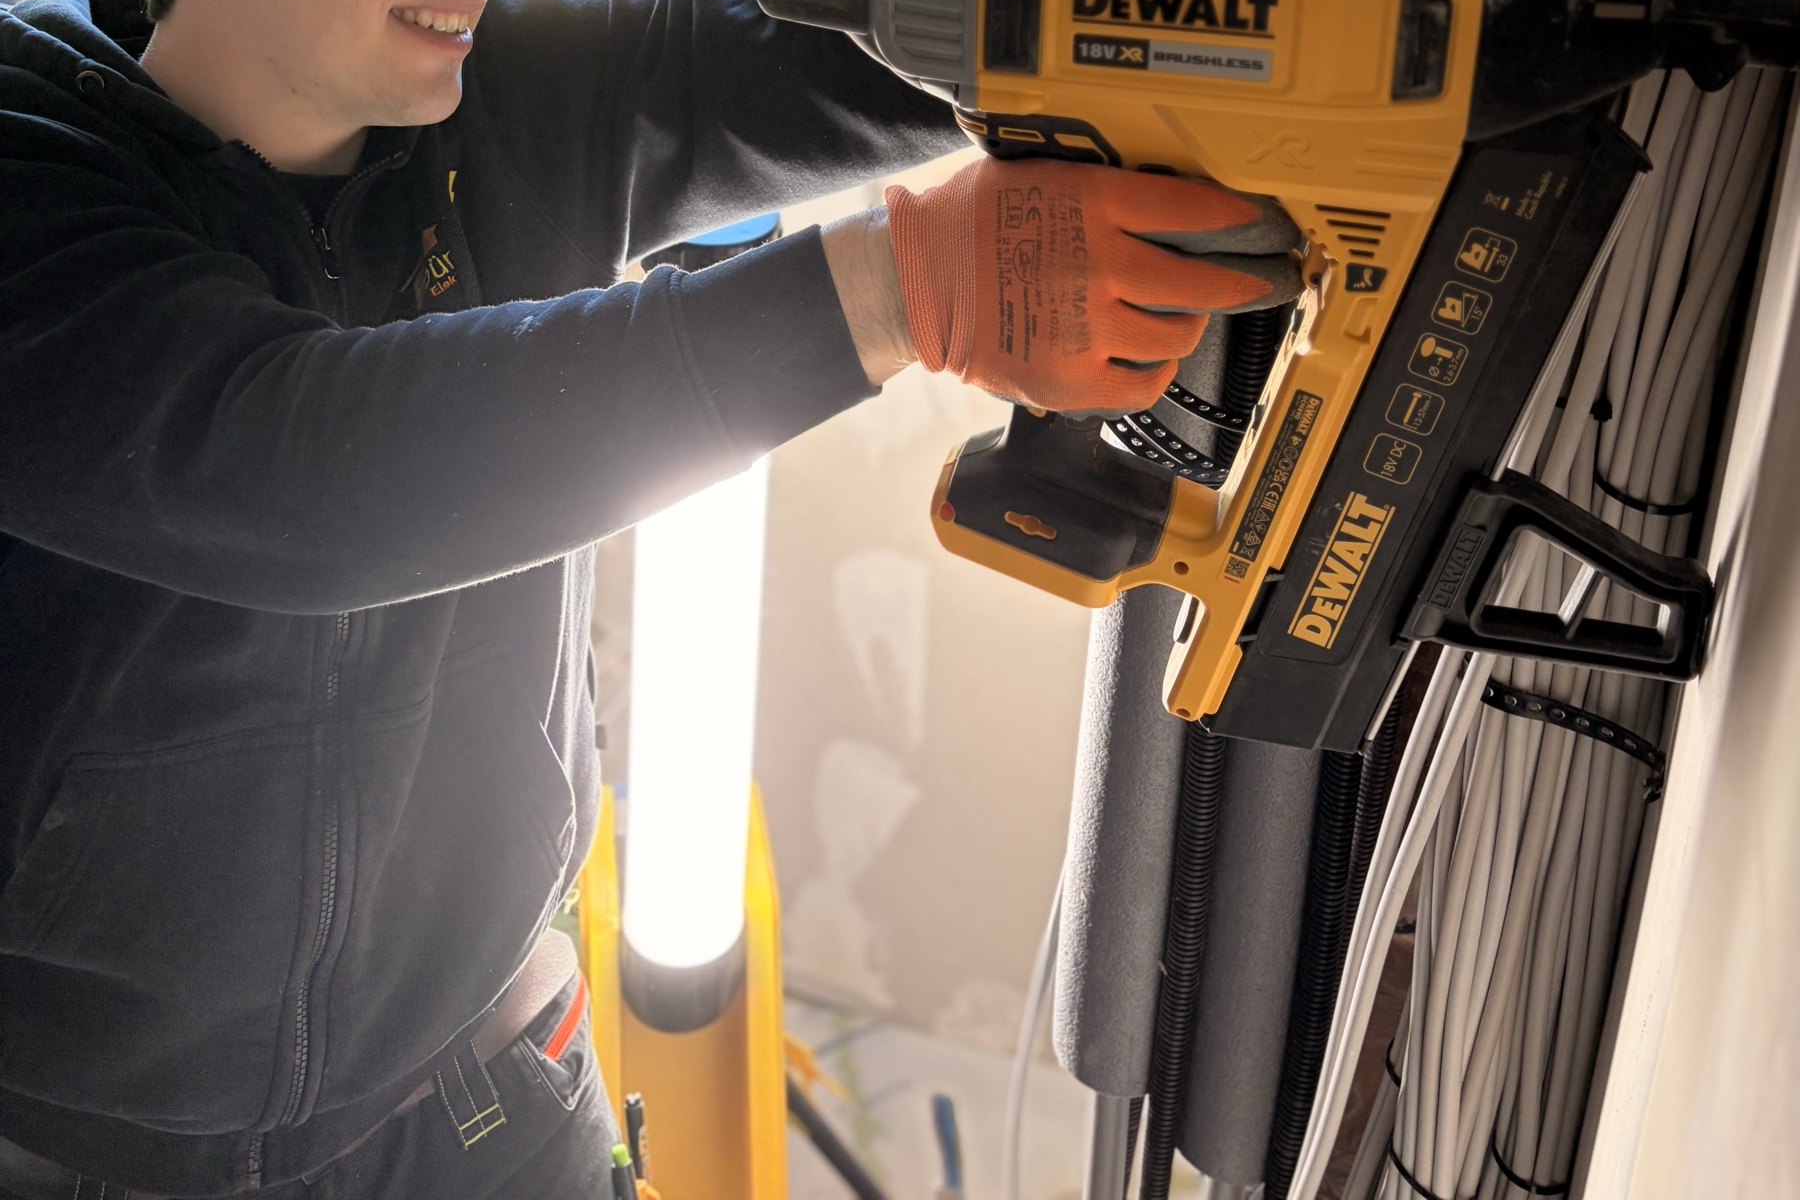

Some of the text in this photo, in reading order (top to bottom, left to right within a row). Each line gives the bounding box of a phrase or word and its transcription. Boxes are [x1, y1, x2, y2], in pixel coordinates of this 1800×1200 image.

[1079, 42, 1264, 70] 18V XR BRUSHLESS
[1515, 197, 1530, 217] Made
[1524, 170, 1553, 220] Czech Republic
[1496, 254, 1508, 266] 33
[1380, 441, 1406, 477] 18V DC
